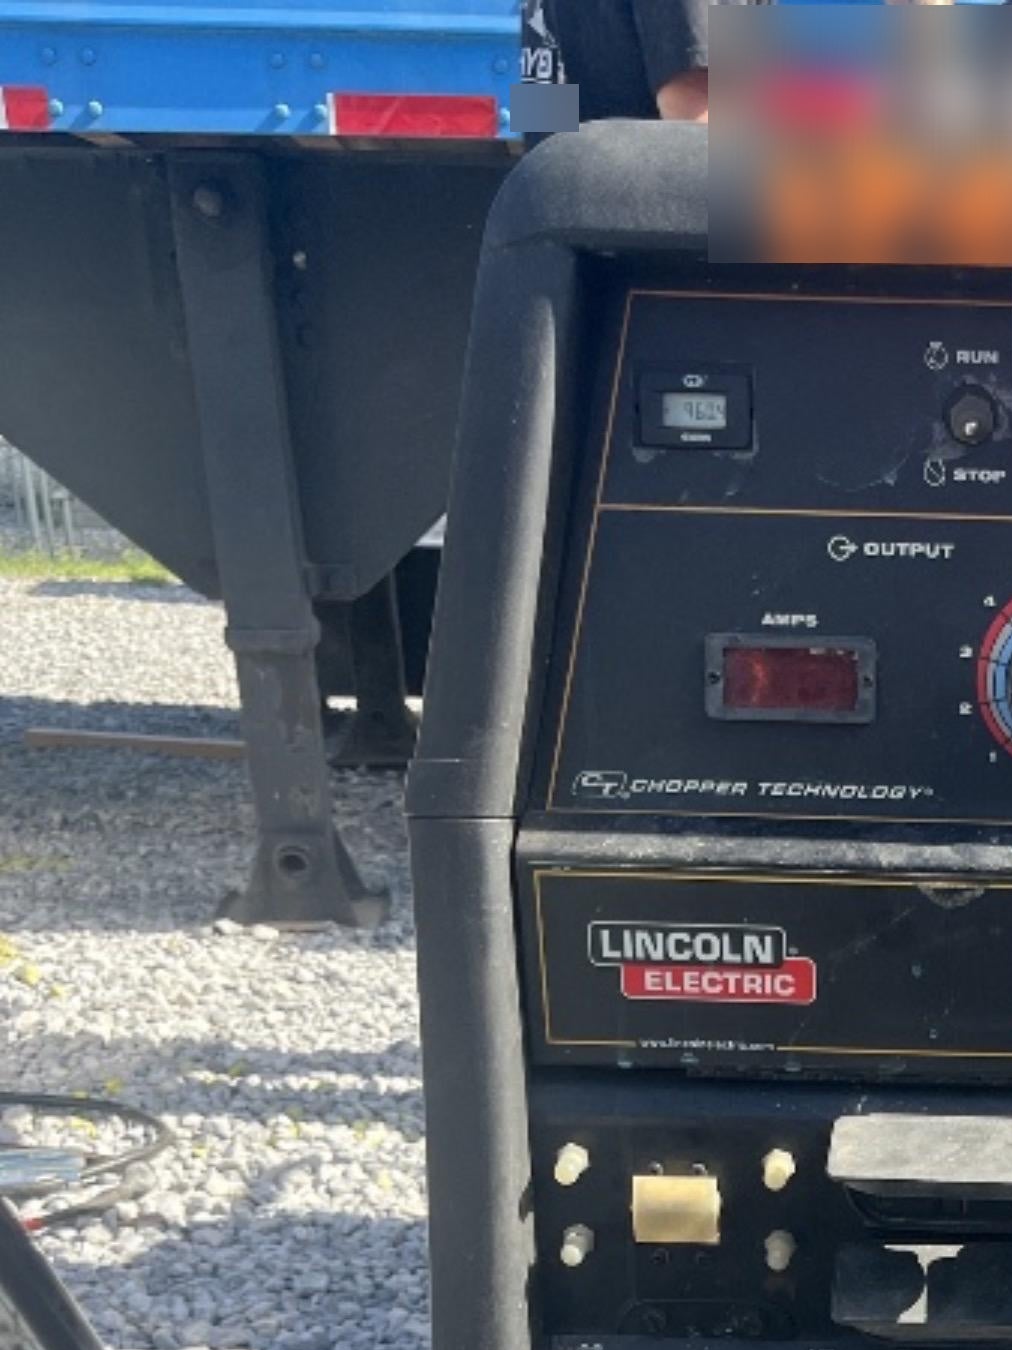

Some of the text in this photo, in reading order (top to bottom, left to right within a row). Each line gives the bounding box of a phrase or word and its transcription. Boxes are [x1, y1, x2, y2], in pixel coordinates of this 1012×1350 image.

[956, 350, 999, 364] RUN
[953, 468, 1006, 484] STOP
[863, 542, 954, 559] OUTPUT
[983, 596, 997, 607] 4
[761, 612, 819, 628] AMPS
[959, 702, 973, 715] 2
[989, 752, 998, 763] 1
[629, 778, 748, 795] CHOPPER
[757, 782, 925, 800] TECHNOLOGY
[600, 929, 774, 964] LINCOLN
[643, 970, 796, 997] ELECTRIC
